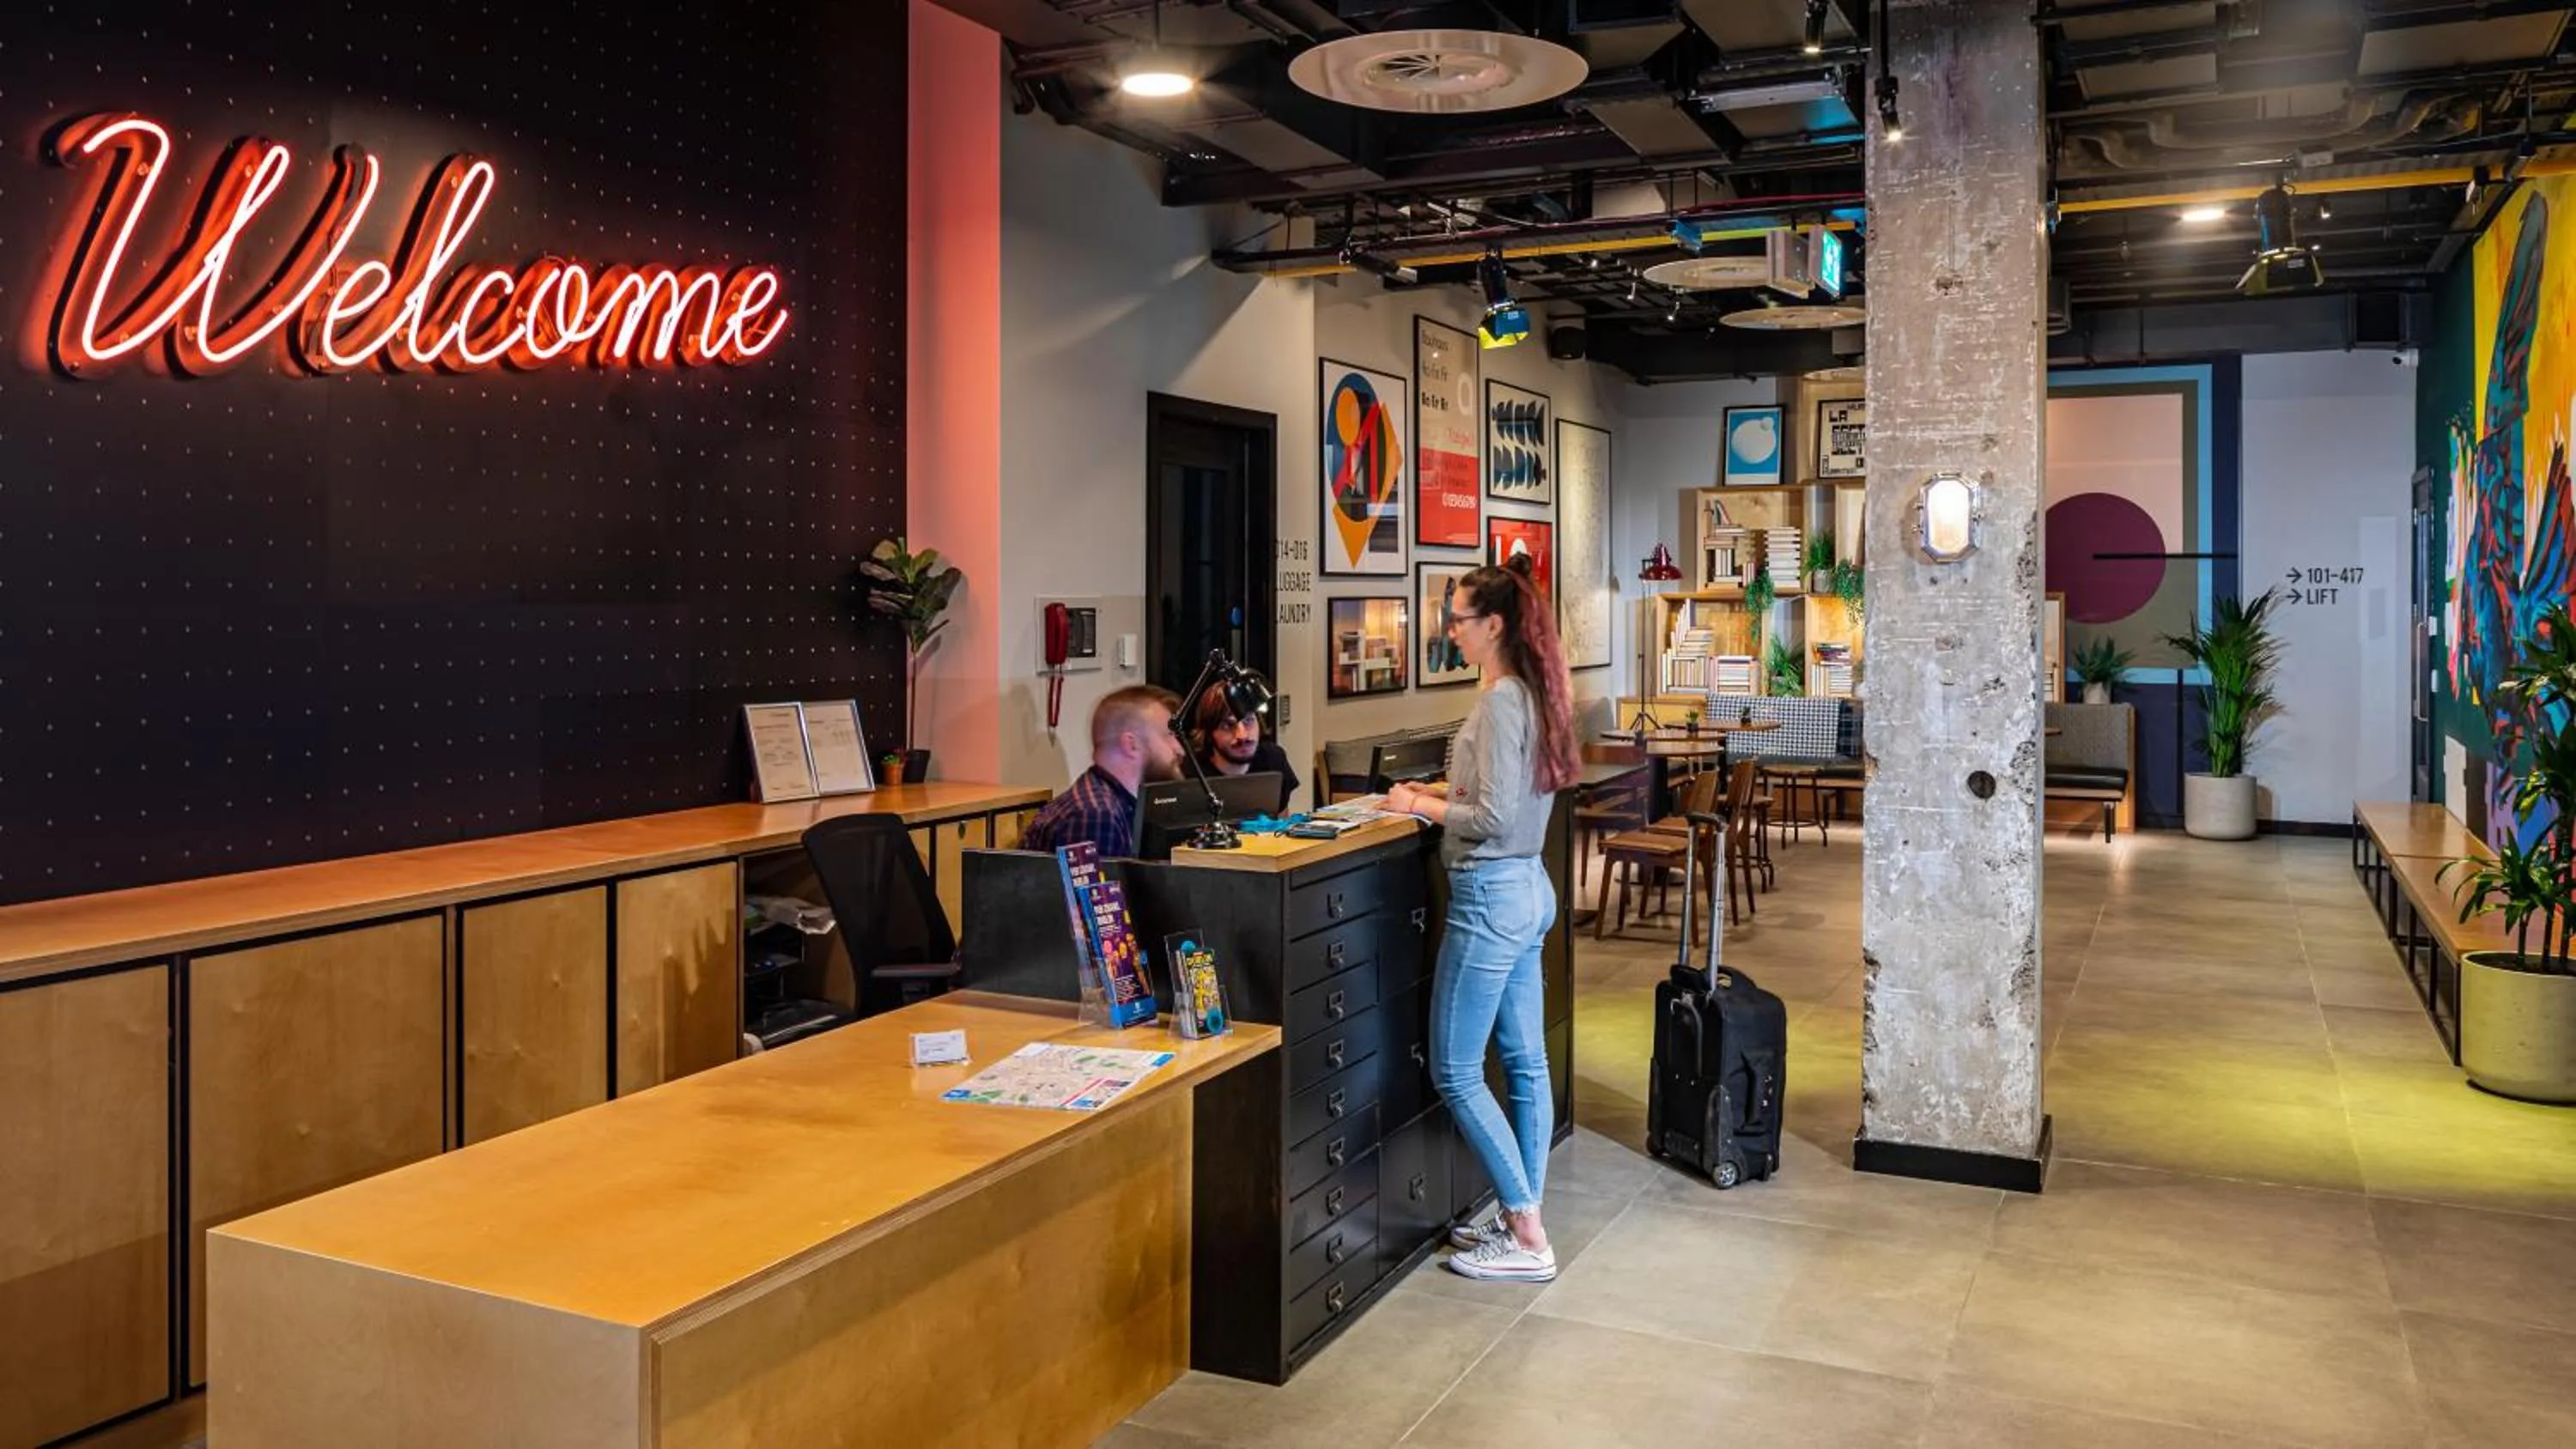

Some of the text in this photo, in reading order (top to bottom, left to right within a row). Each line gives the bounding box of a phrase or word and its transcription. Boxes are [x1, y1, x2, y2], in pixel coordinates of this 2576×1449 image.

[77, 118, 787, 366] Welcome
[1275, 539, 1308, 561] 14-016
[1275, 571, 1311, 591] UGGAGE
[2307, 567, 2364, 584] 101-417
[2306, 588, 2338, 604] LIFT
[1275, 603, 1311, 624] AUNDRY
